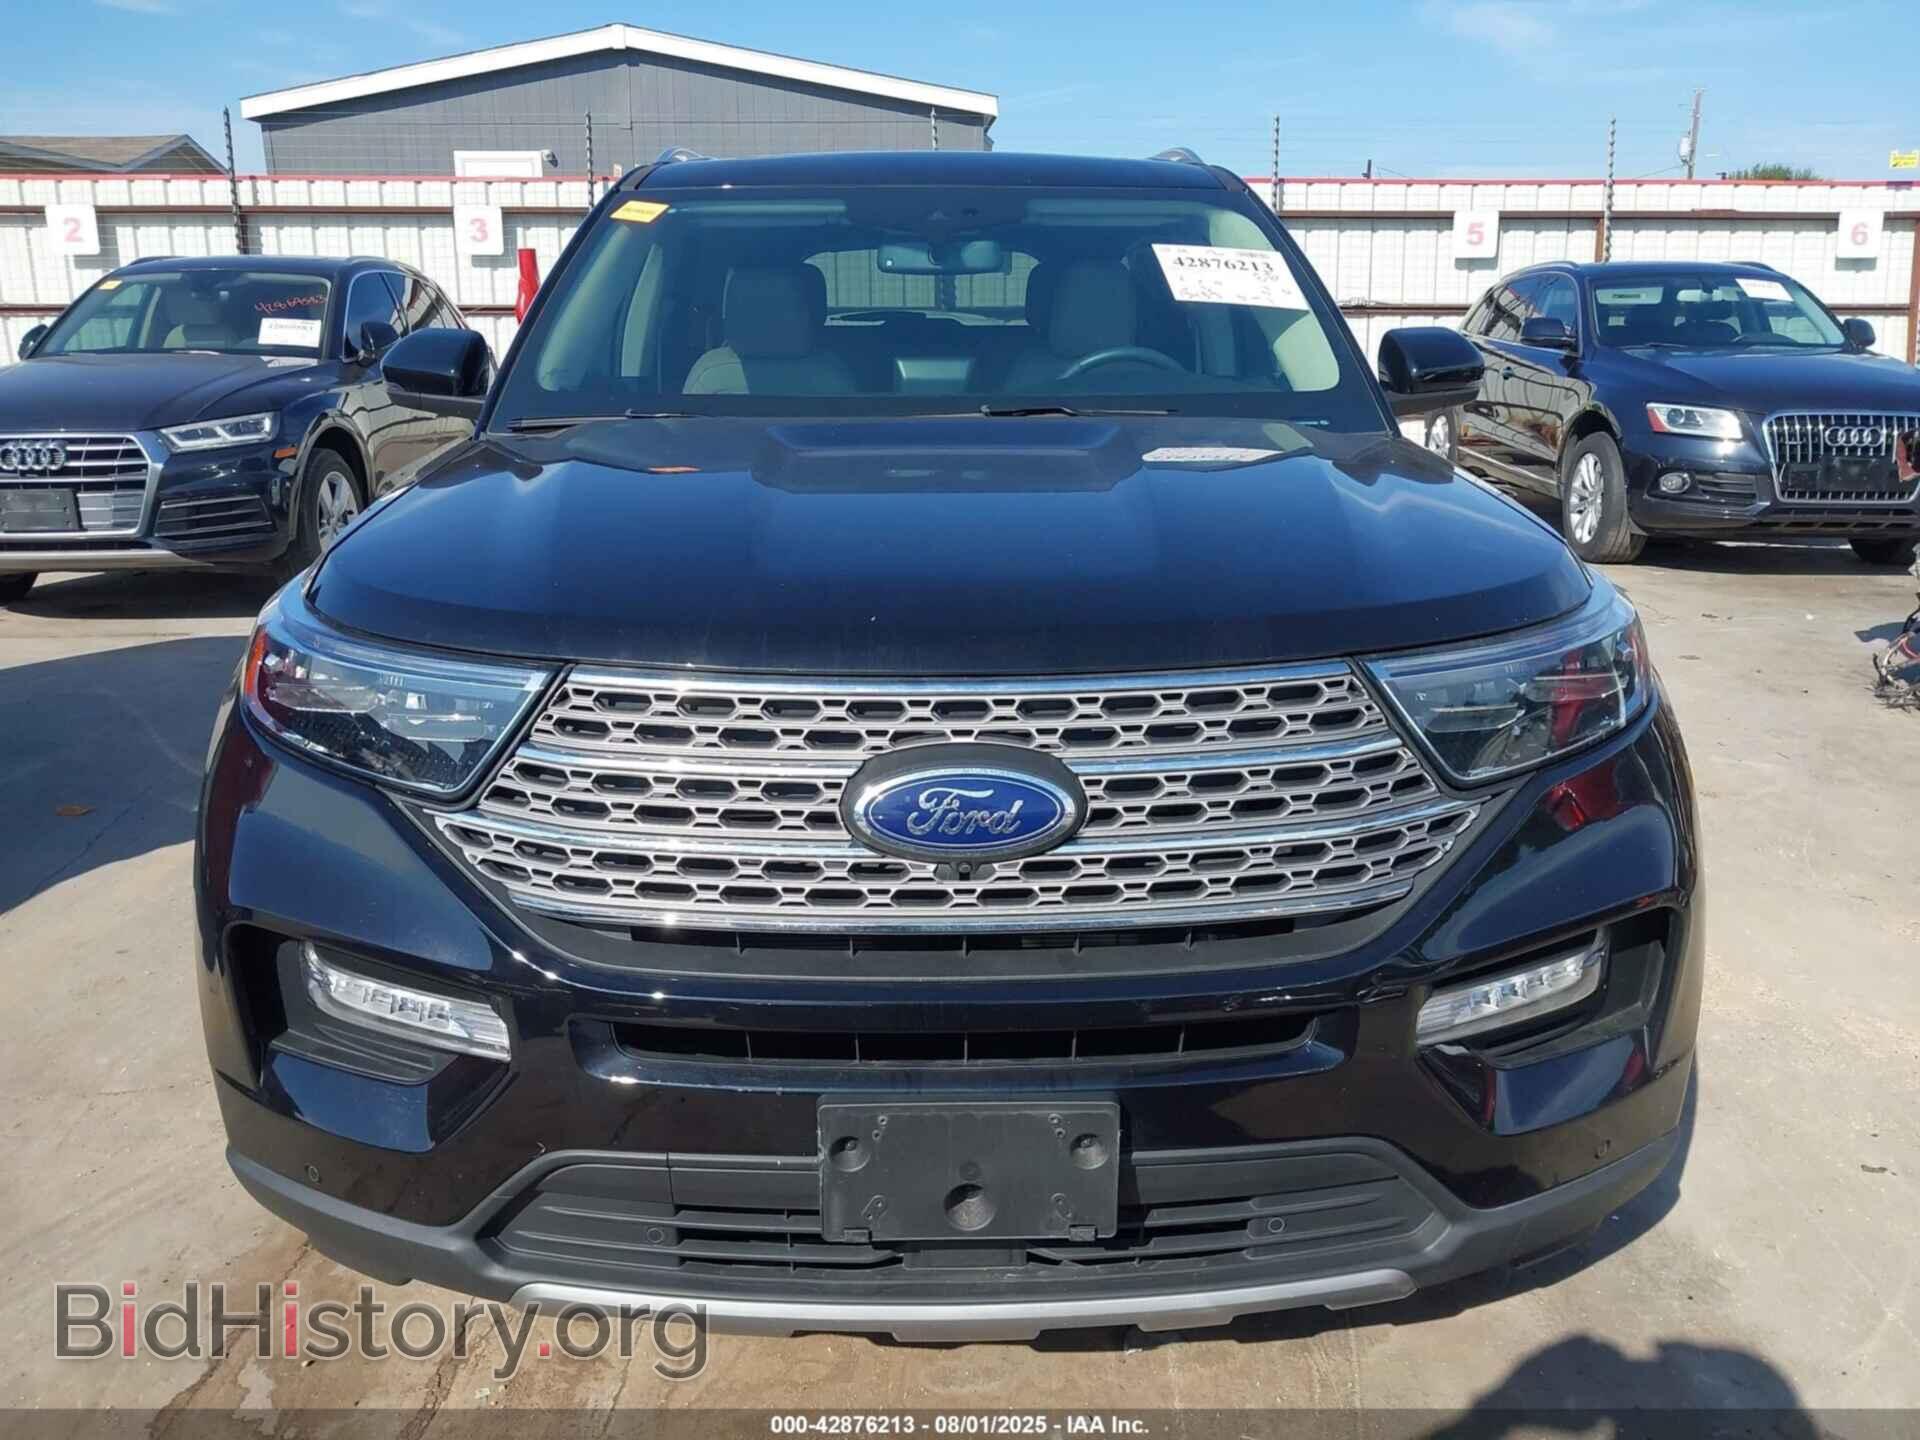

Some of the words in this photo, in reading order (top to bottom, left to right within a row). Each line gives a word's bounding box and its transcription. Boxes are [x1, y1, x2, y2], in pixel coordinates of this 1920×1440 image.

[64, 217, 84, 242] 2
[470, 218, 488, 242] 3
[1466, 222, 1484, 245] 5
[1851, 222, 1868, 246] 6
[1173, 256, 1273, 272] 42876213
[906, 787, 1024, 835] Ford
